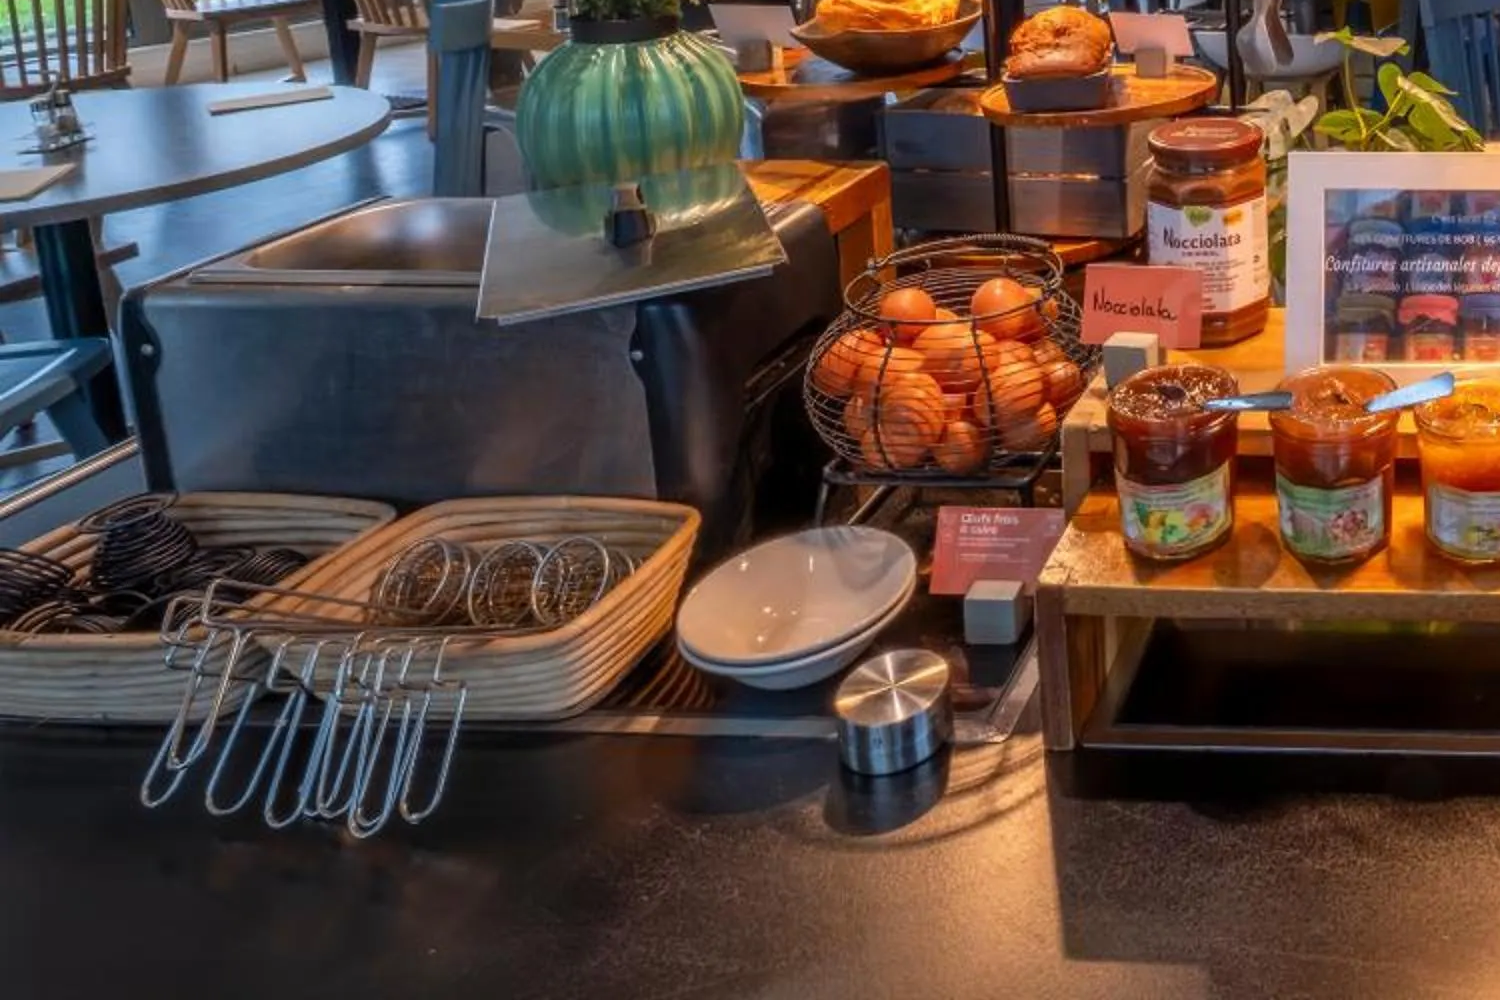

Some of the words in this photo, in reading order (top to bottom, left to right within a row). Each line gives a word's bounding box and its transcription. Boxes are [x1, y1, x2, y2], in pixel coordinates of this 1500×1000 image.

[1163, 226, 1241, 249] Nocciolata
[1325, 254, 1396, 273] Confitures
[1400, 254, 1476, 273] artisanales
